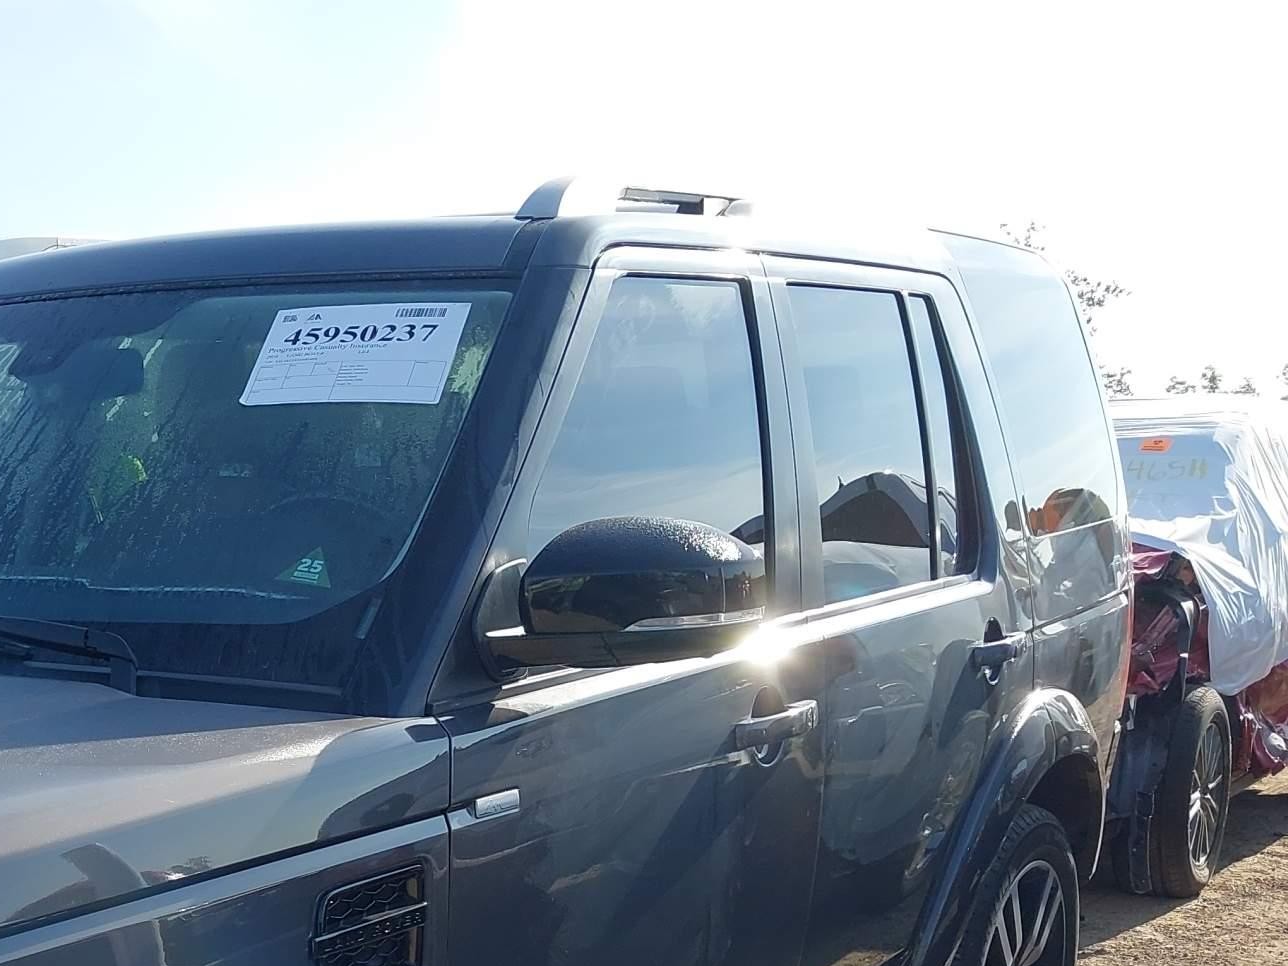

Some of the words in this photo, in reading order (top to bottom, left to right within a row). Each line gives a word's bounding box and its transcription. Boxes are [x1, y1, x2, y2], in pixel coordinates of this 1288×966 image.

[284, 324, 439, 346] 45950237
[267, 344, 312, 354] Progressive
[297, 558, 325, 573] 25
